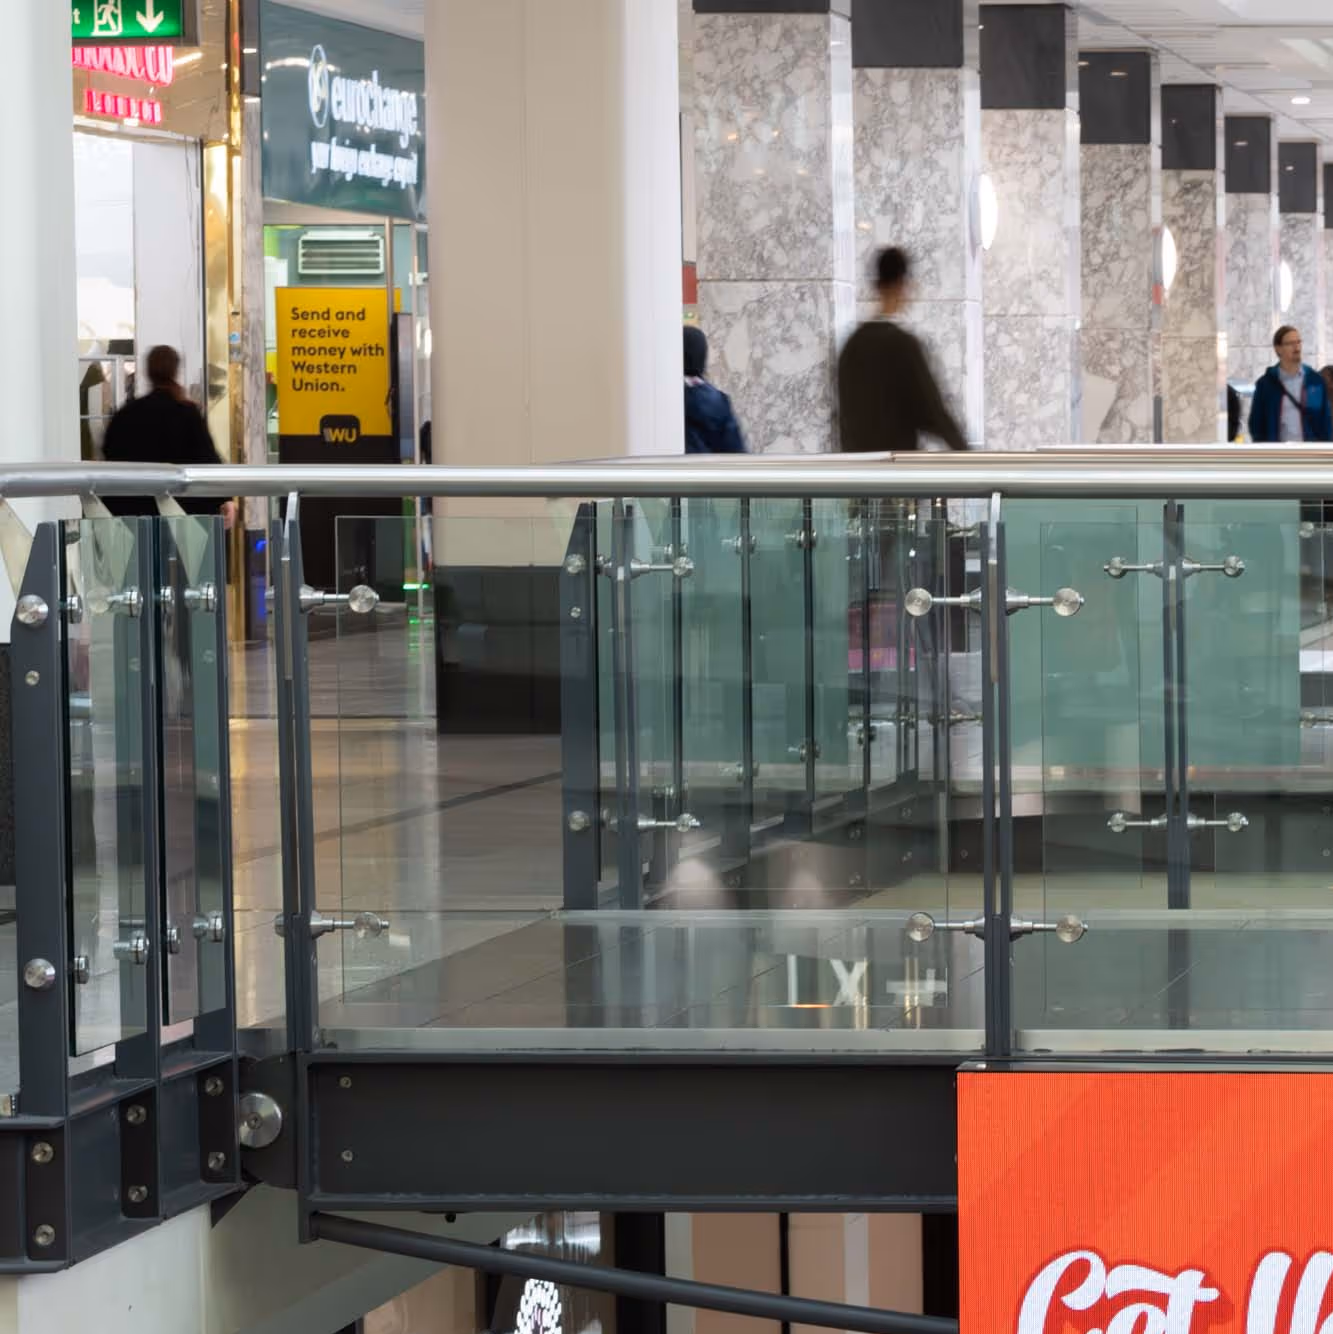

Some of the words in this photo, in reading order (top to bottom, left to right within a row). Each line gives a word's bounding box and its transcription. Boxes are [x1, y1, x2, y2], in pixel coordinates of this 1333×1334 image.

[331, 69, 417, 149] eurochange
[291, 307, 331, 321] Send
[335, 307, 366, 321] and
[291, 325, 351, 338] receive
[291, 346, 346, 359] money
[350, 343, 385, 357] with
[291, 360, 357, 374] Western
[291, 378, 345, 392] Union.
[329, 428, 357, 442] WU
